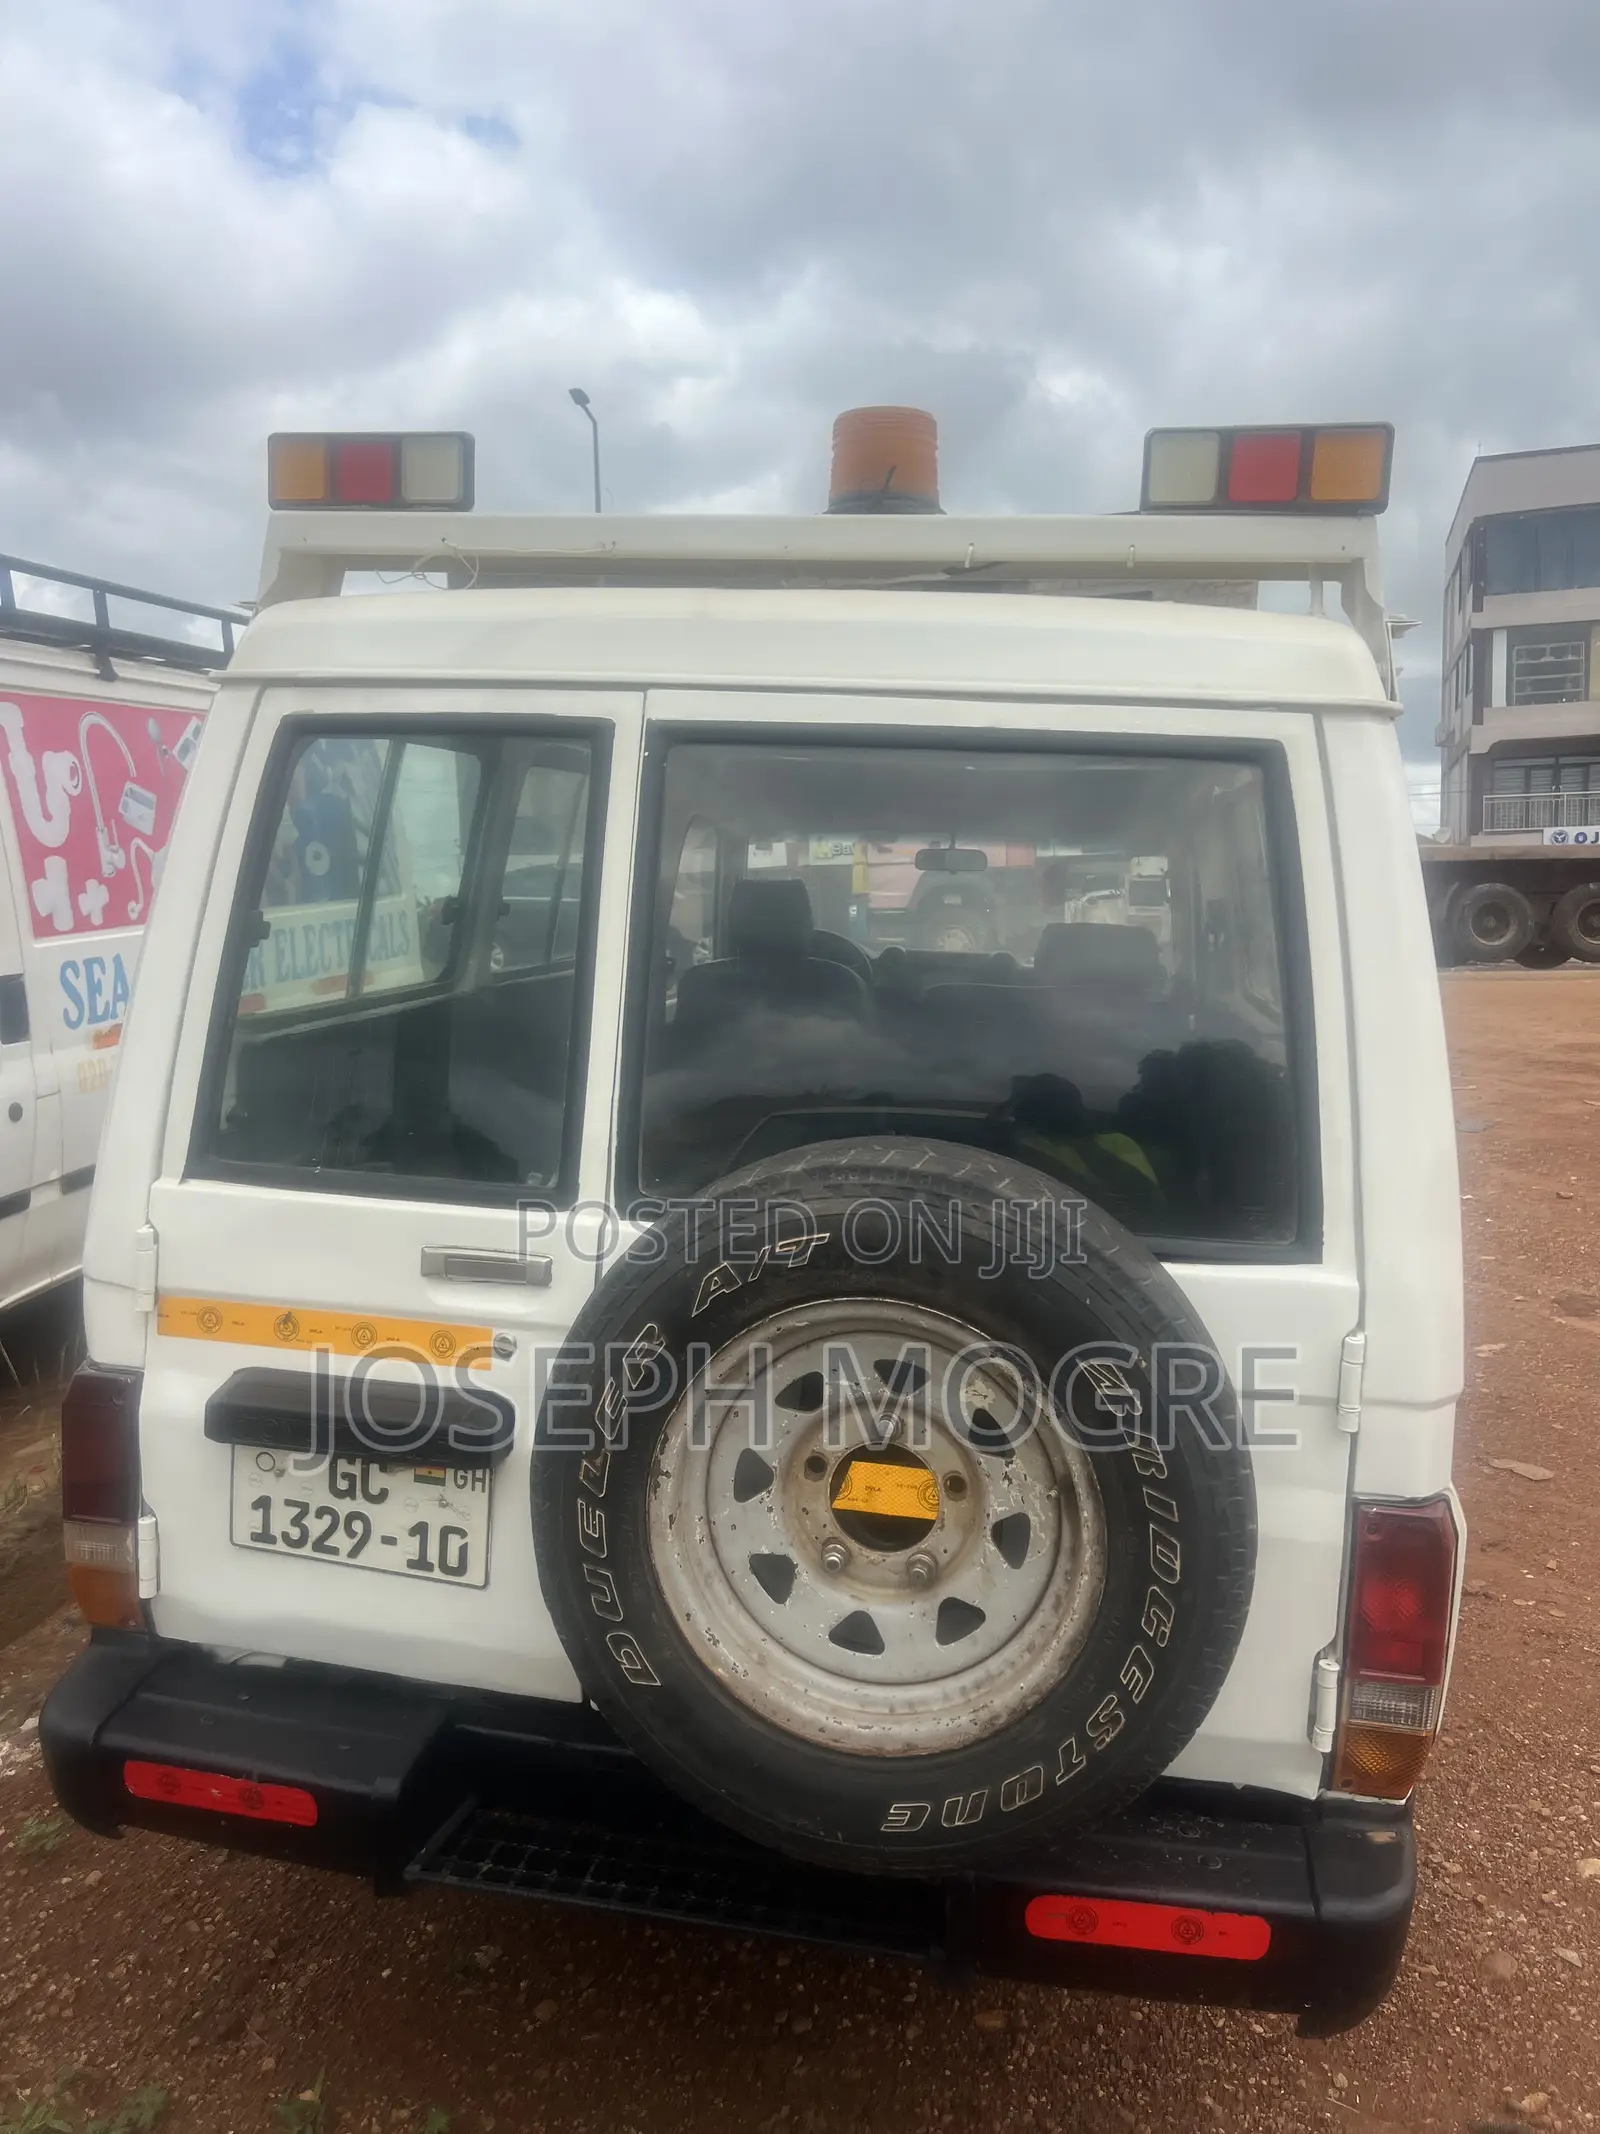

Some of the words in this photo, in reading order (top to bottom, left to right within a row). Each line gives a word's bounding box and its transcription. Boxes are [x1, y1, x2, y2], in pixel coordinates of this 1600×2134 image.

[691, 1234, 830, 1317] A/T
[328, 1457, 389, 1505] GC
[453, 1469, 487, 1494] GH
[577, 1323, 665, 1686] DUELER
[250, 1495, 469, 1578] 1329-10
[879, 1357, 1181, 1832] BRIDGESTONE
